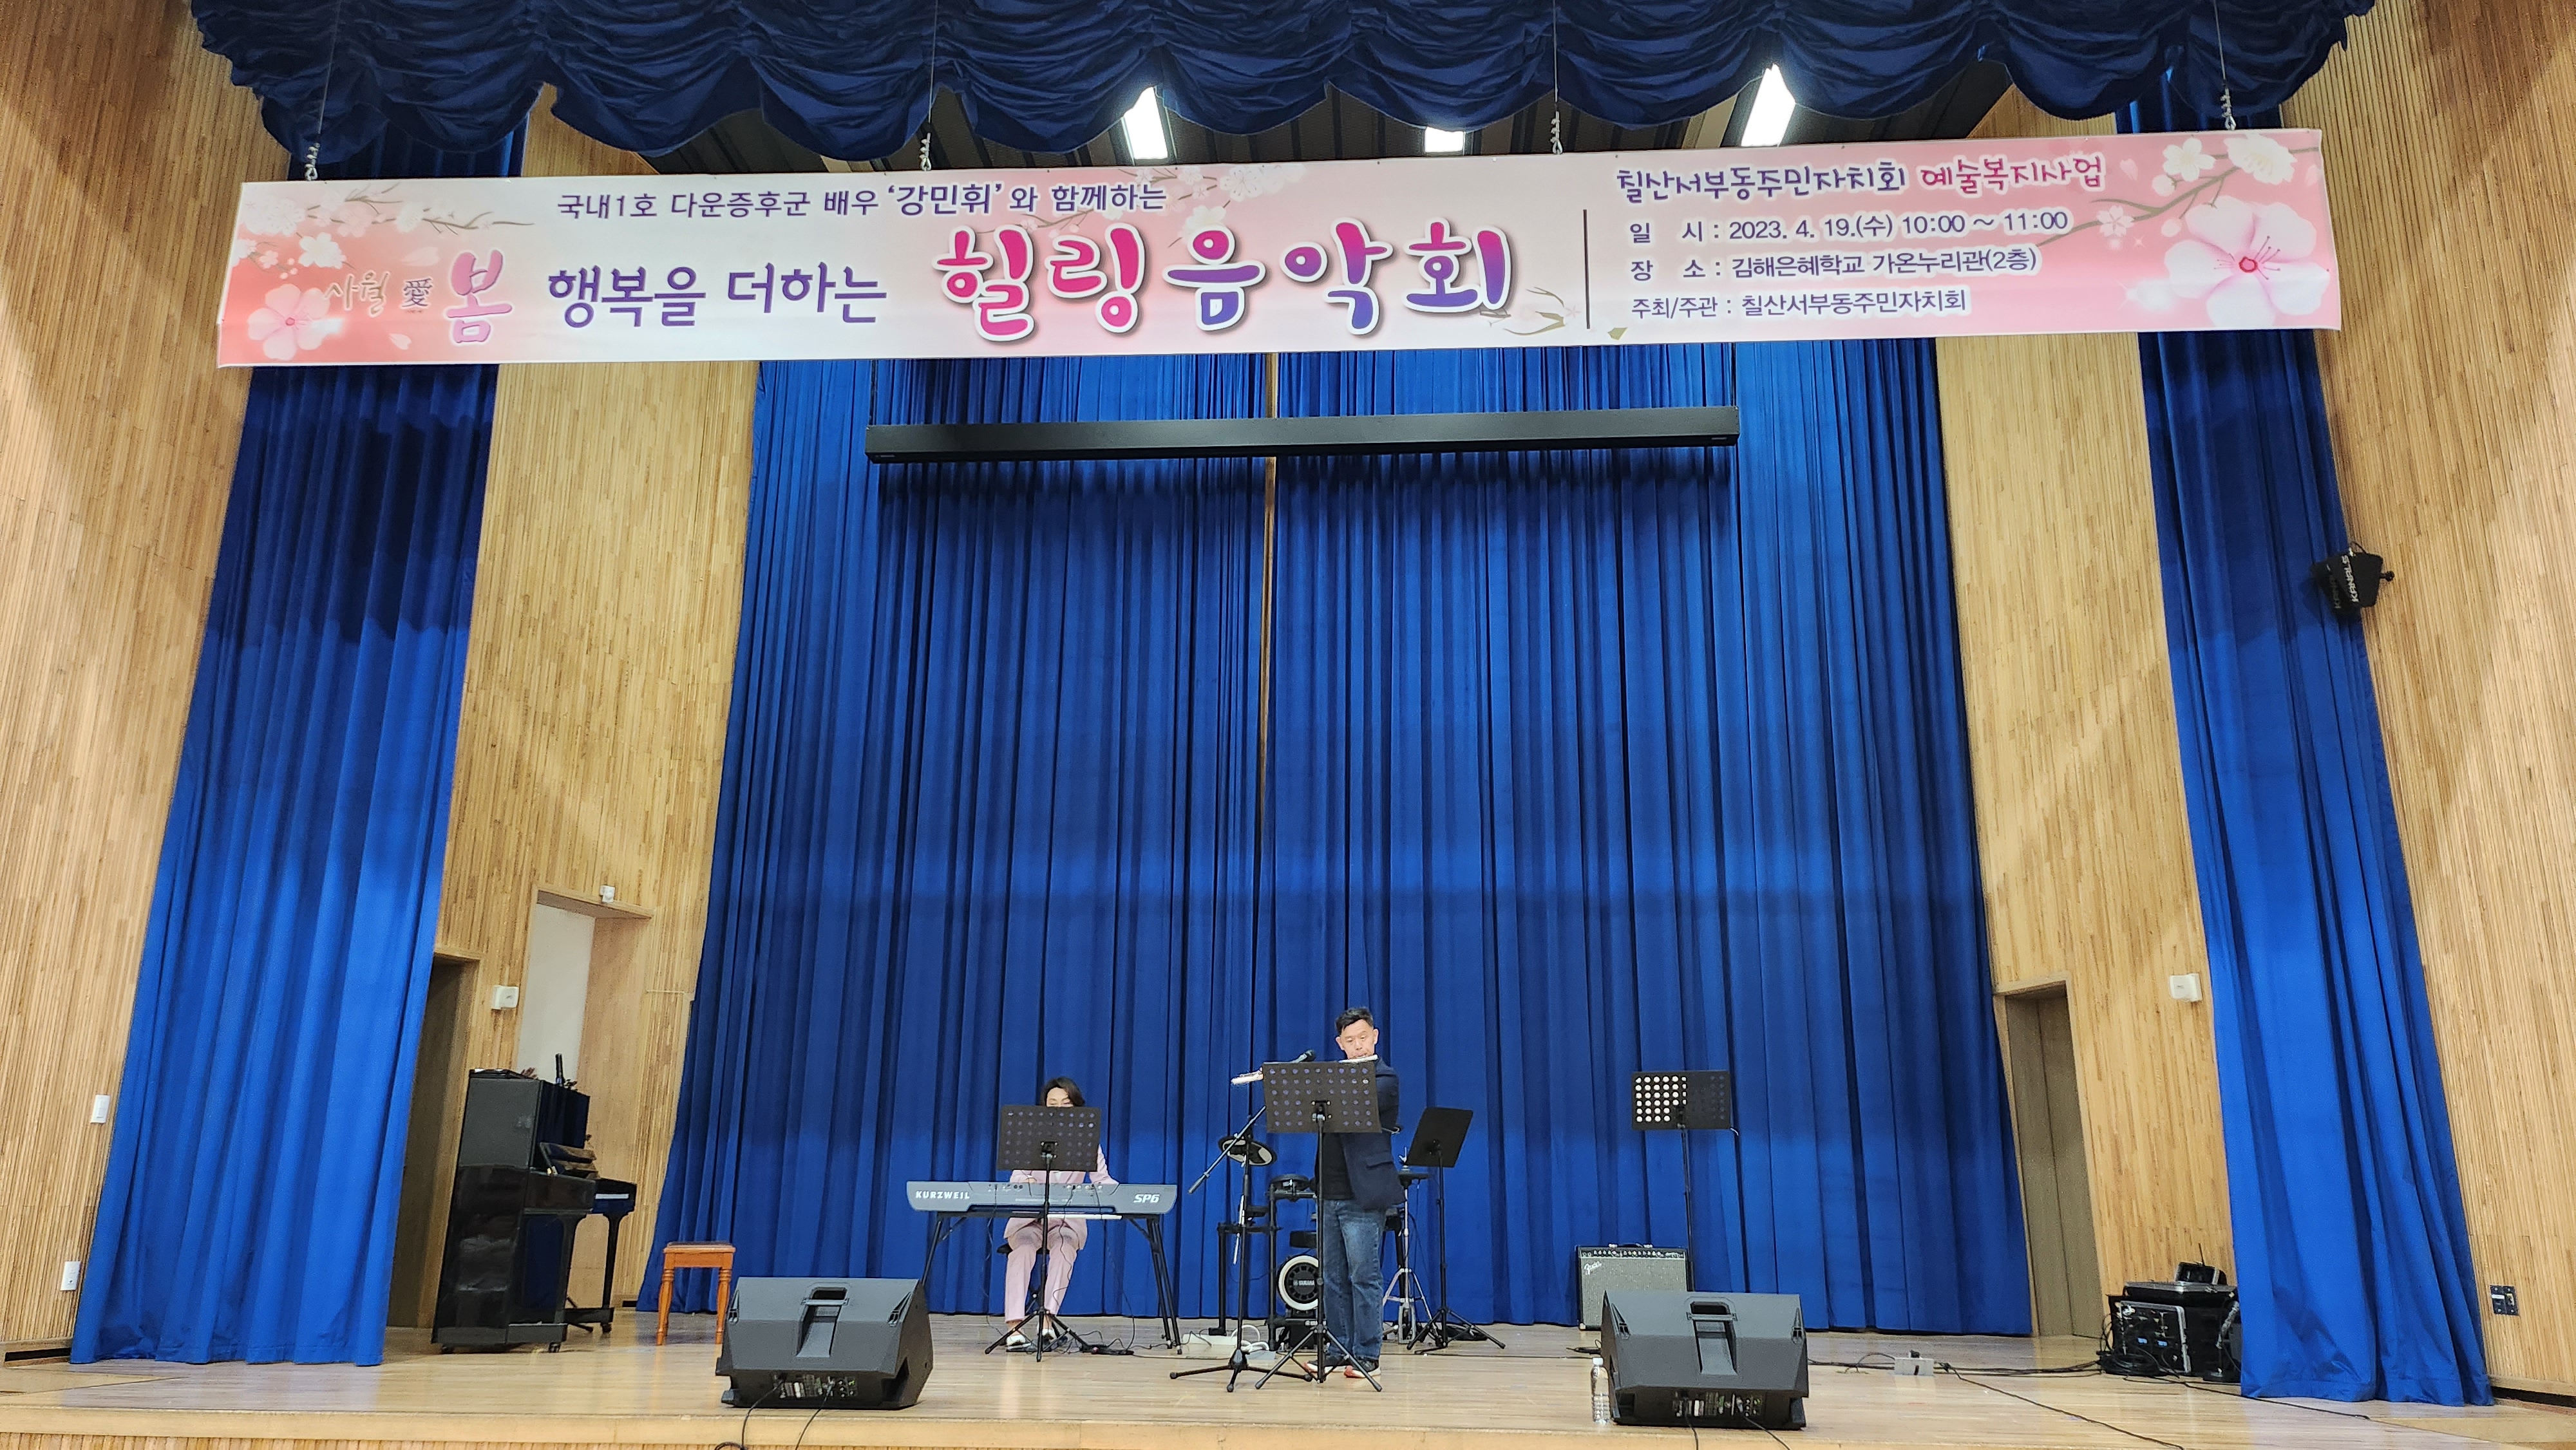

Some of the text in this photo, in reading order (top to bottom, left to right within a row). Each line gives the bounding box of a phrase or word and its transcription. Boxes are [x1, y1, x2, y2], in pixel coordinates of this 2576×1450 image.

[1616, 155, 2103, 203] 칠산서부동주민자치회 예술복지사업
[557, 193, 657, 219] 국내1호
[671, 191, 810, 218] 다운증후군
[824, 189, 878, 216] 배우
[1051, 184, 1167, 212] 함께하는
[1902, 215, 1966, 234] 10:00
[2004, 211, 2069, 231] 11:00
[1732, 254, 1865, 278] 김해은혜학교
[324, 249, 513, 343] 사월 愛 봄
[548, 265, 706, 328] 행복을
[727, 261, 887, 323] 더하는
[1632, 296, 1718, 319] 주최/주관
[1741, 290, 1966, 316] 칠산서부동주민자치회
[916, 1191, 970, 1200] KURZWEIL
[1133, 1194, 1160, 1203] SP6
